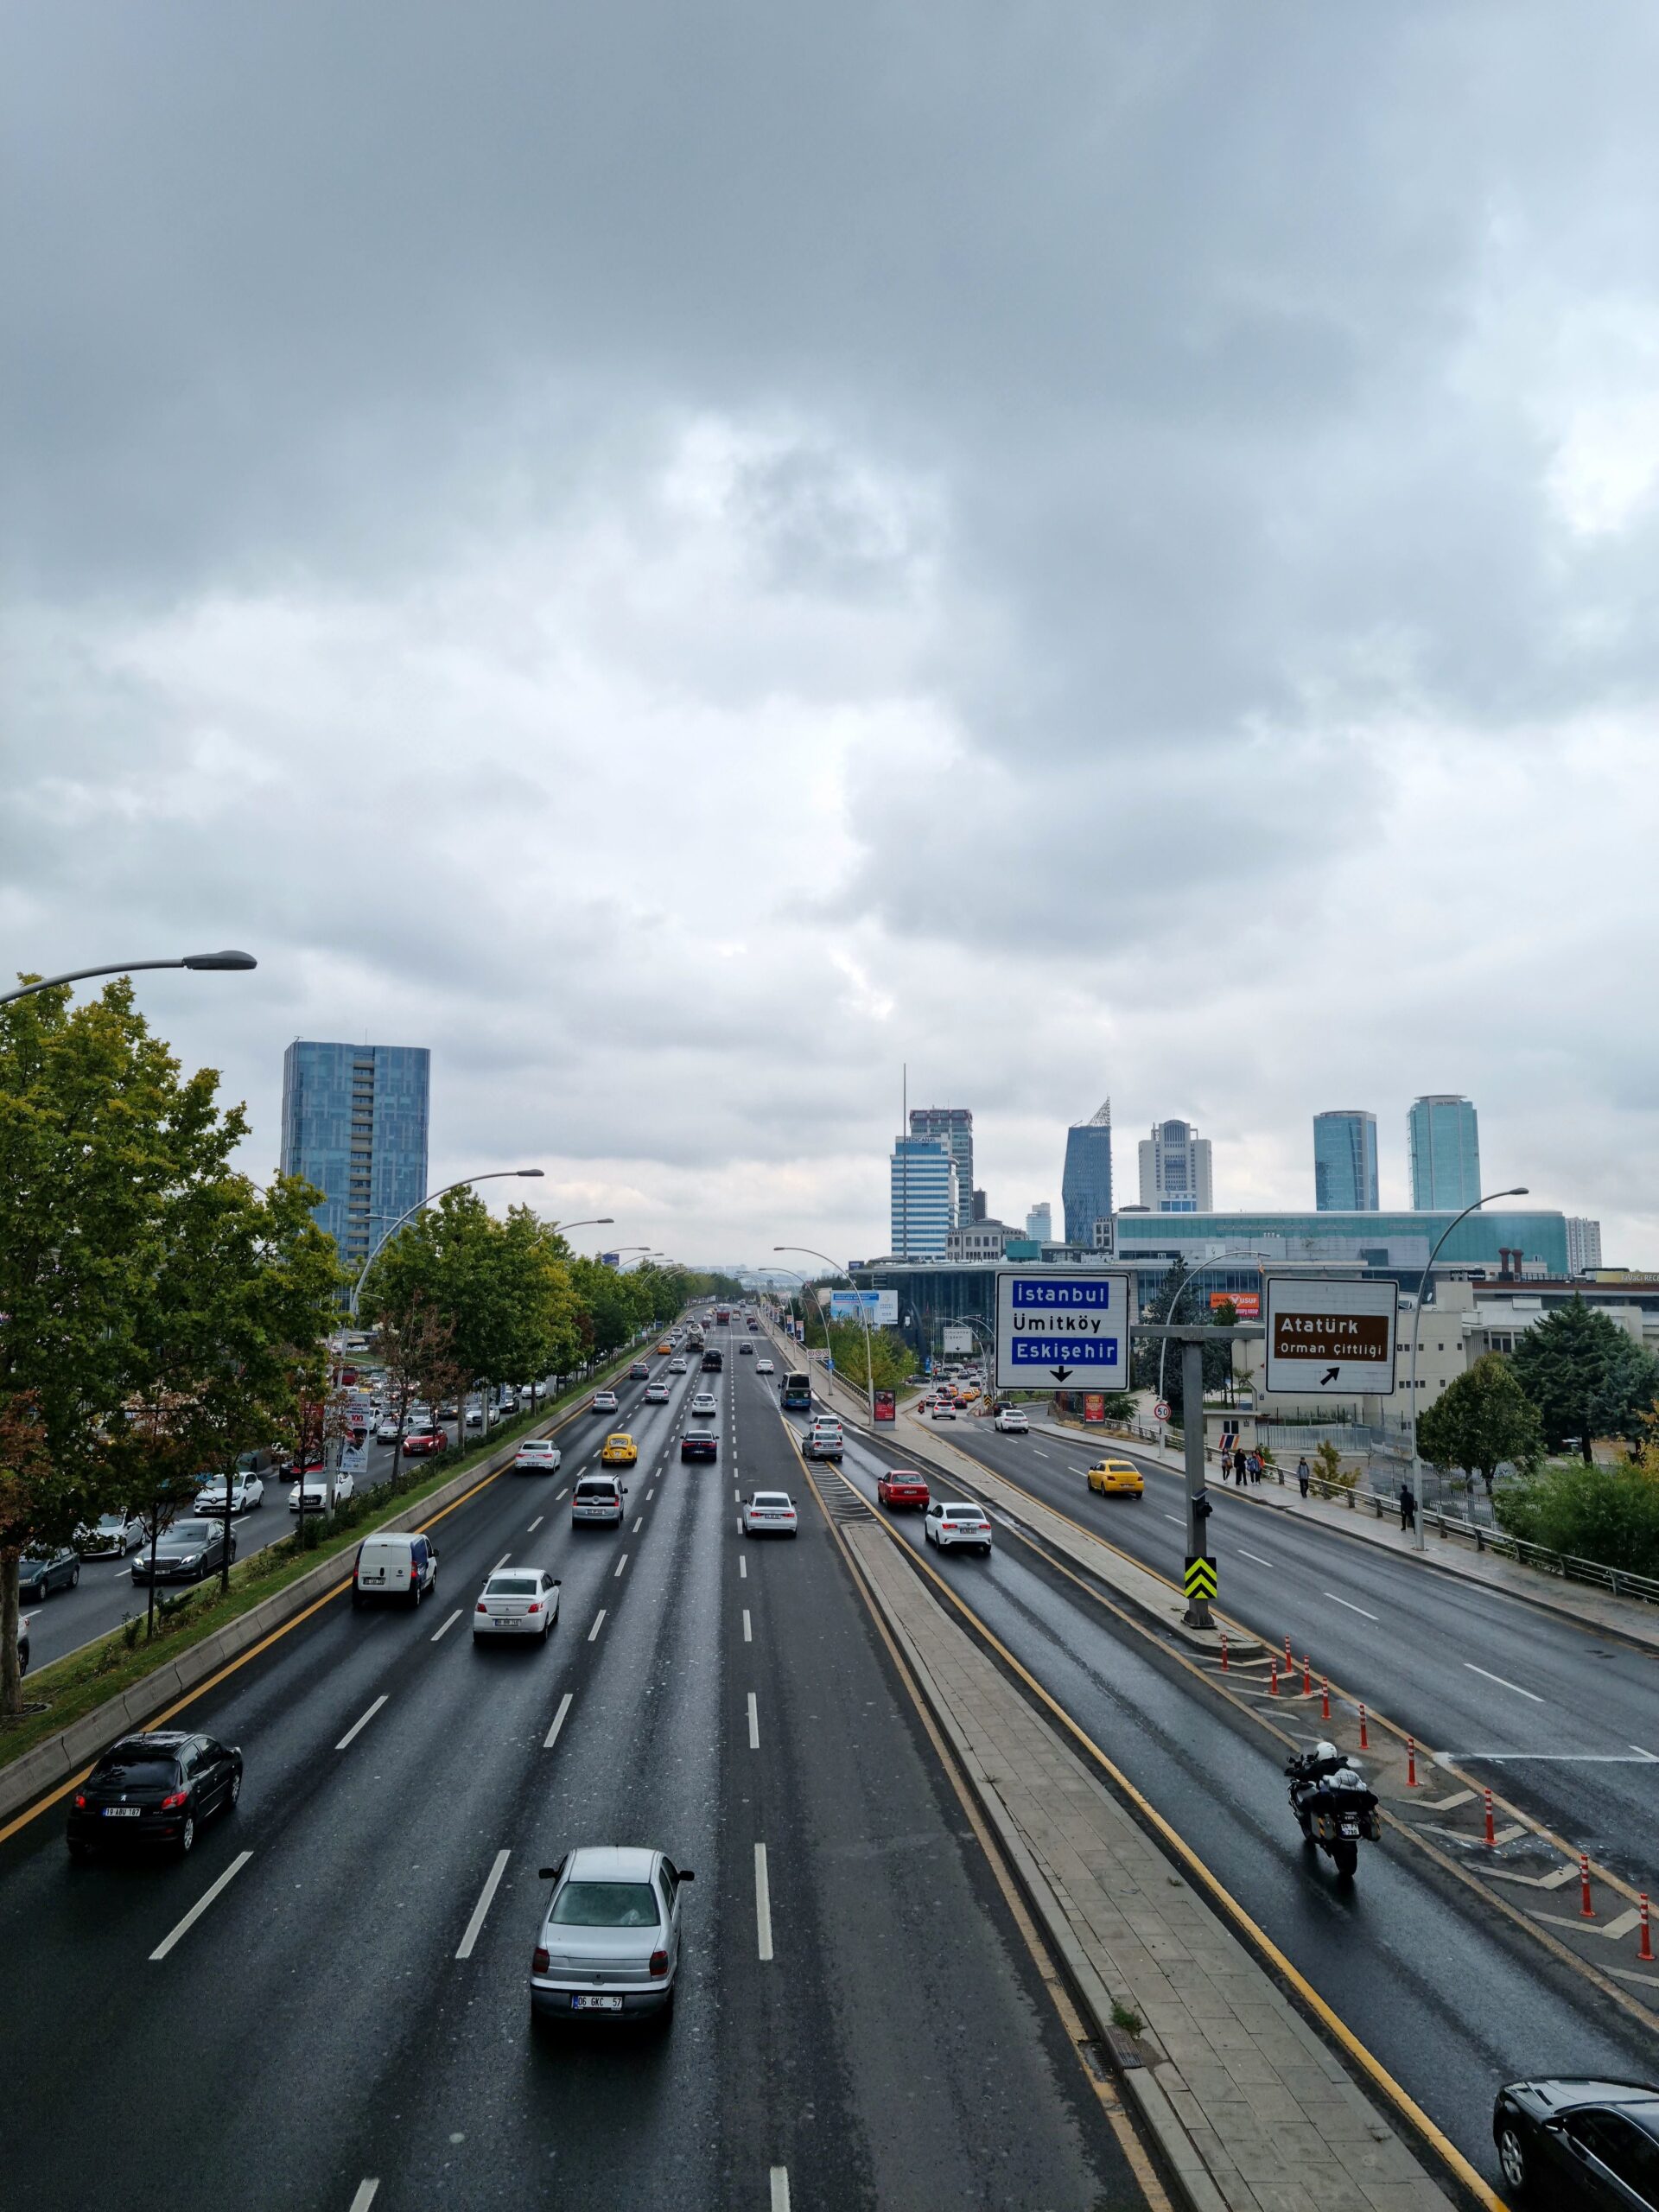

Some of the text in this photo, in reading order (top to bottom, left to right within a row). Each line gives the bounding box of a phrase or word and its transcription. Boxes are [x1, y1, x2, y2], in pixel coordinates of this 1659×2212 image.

[1018, 1283, 1104, 1302] İstanbul
[1014, 1313, 1102, 1334] Ümitköy
[1281, 1318, 1358, 1334] Atatürk
[1017, 1343, 1116, 1360] Eskişehir
[1281, 1343, 1382, 1357] Orman Çiftliği
[578, 1997, 621, 2007] 06 GKC 57
